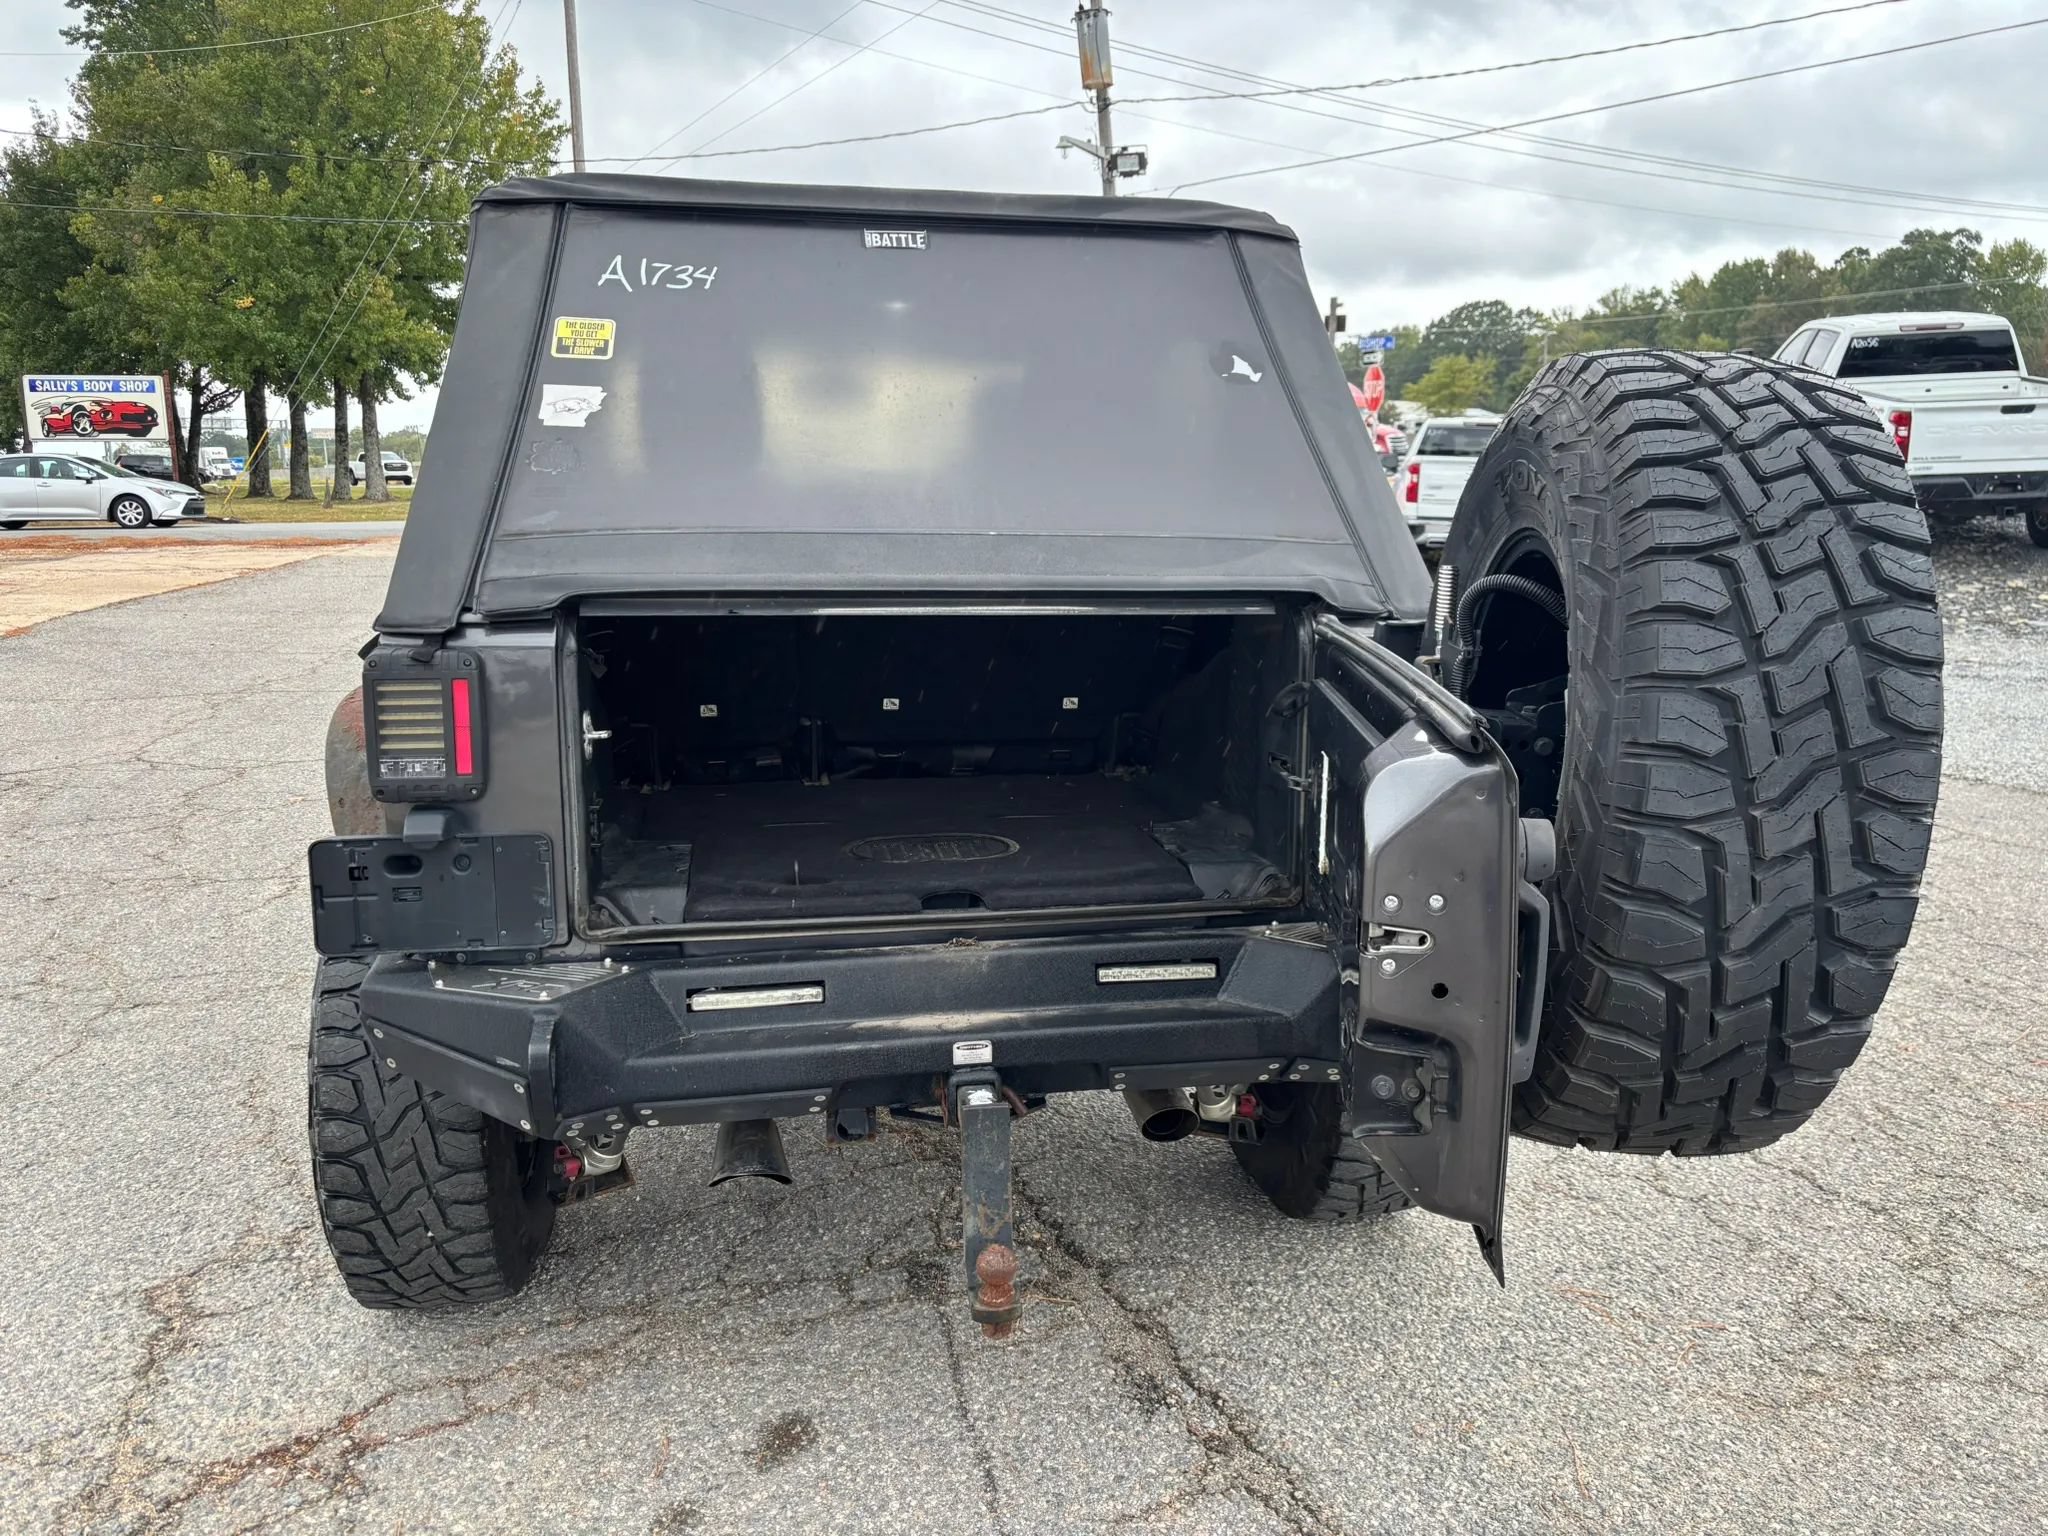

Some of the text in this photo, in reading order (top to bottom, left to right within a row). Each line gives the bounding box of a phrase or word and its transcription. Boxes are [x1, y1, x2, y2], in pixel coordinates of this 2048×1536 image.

[871, 233, 926, 248] BATTLE
[597, 254, 718, 293] A1734
[565, 321, 605, 331] THE CLOSER
[570, 329, 598, 338] YOU GET
[562, 338, 605, 348] THE SLOWER
[569, 346, 595, 355] I DRIVE
[35, 380, 150, 392] SALLY'S BODY SHOP
